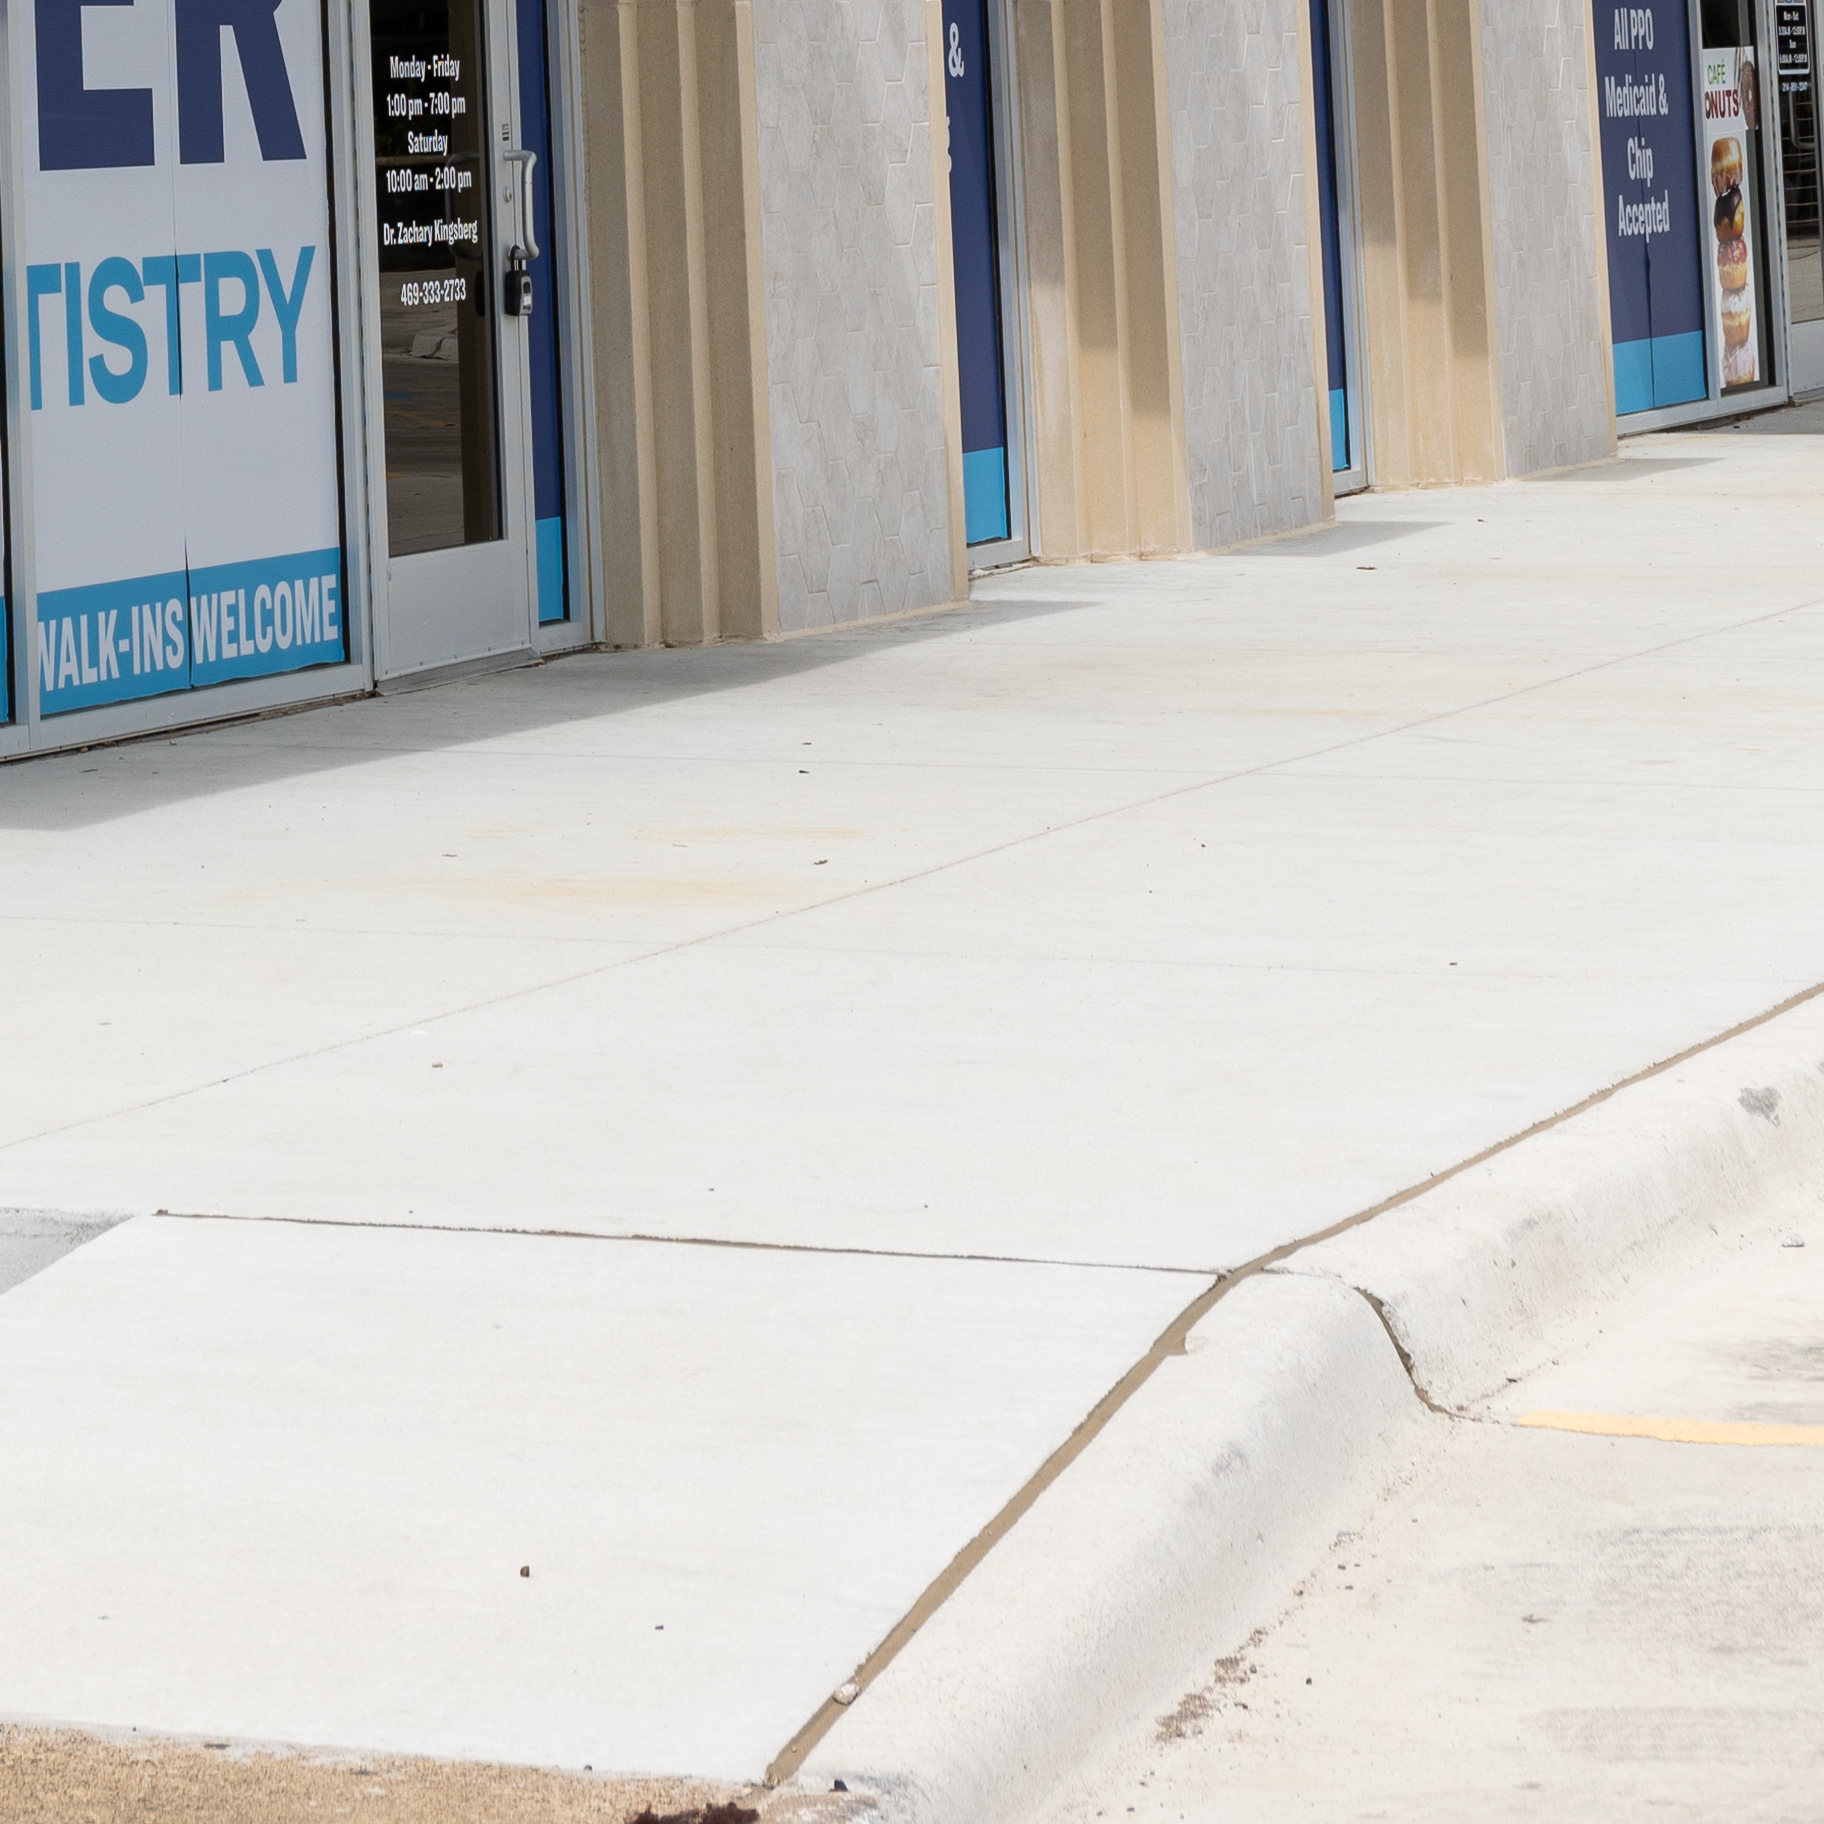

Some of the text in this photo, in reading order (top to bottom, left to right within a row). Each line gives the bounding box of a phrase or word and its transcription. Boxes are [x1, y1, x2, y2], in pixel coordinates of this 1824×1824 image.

[1614, 7, 1654, 51] All PPO
[948, 21, 964, 78] &
[389, 54, 426, 83] Monday
[432, 53, 460, 82] Friday
[1707, 58, 1726, 85] CAFÉ
[386, 93, 407, 117] 1:00
[408, 98, 423, 121] pm
[429, 91, 450, 115] 7:00
[451, 96, 466, 119] pm
[1604, 72, 1669, 118] Medicaid &
[1704, 88, 1740, 120] ONUTS
[407, 128, 448, 157] Saturday
[1627, 135, 1654, 188] Chip
[386, 168, 413, 193] 10:00
[414, 173, 429, 191] am
[435, 166, 456, 190] 2:00
[457, 171, 472, 193] pm
[383, 216, 479, 247] Dr. Zachary Kingsberg
[1618, 189, 1670, 244] Accepted
[400, 277, 467, 307] 469-333-2733
[190, 574, 339, 665] WELCOME
